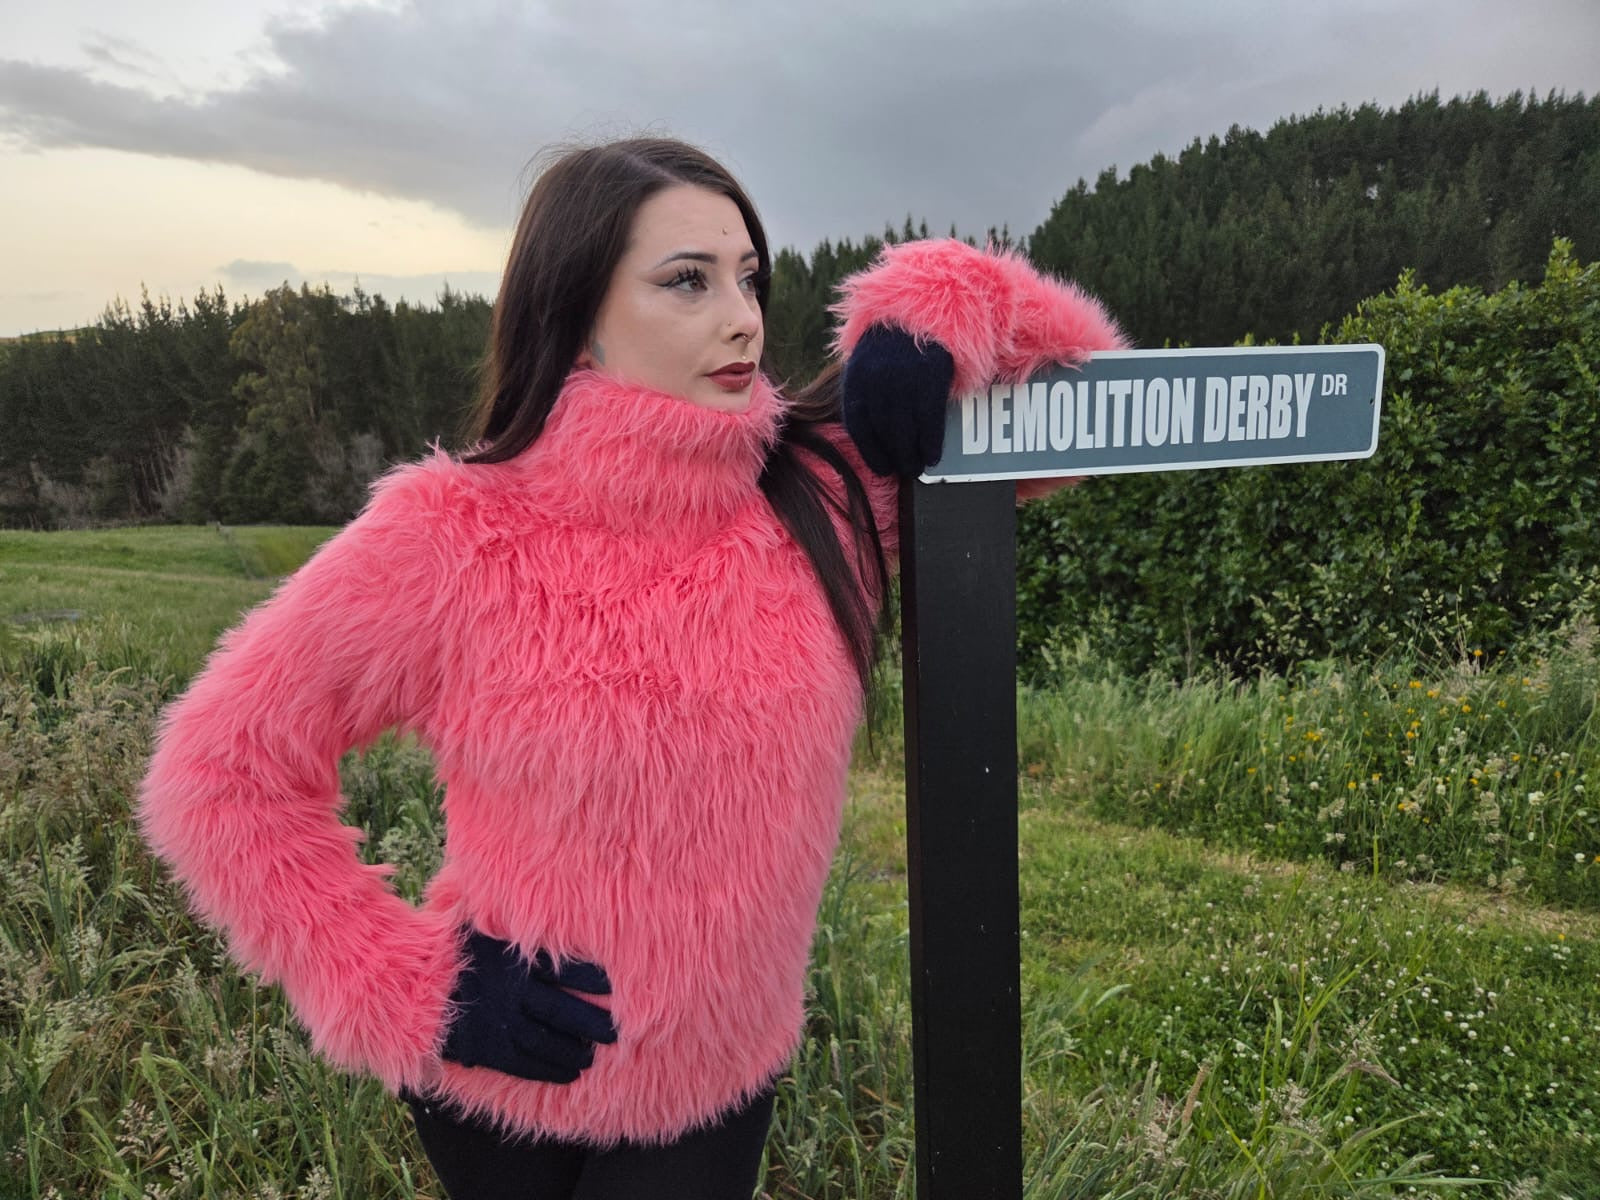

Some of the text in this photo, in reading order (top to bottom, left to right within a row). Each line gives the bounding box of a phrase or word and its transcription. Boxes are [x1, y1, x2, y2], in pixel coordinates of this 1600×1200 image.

[961, 373, 1348, 455] DEMOLITION DERBY DR
